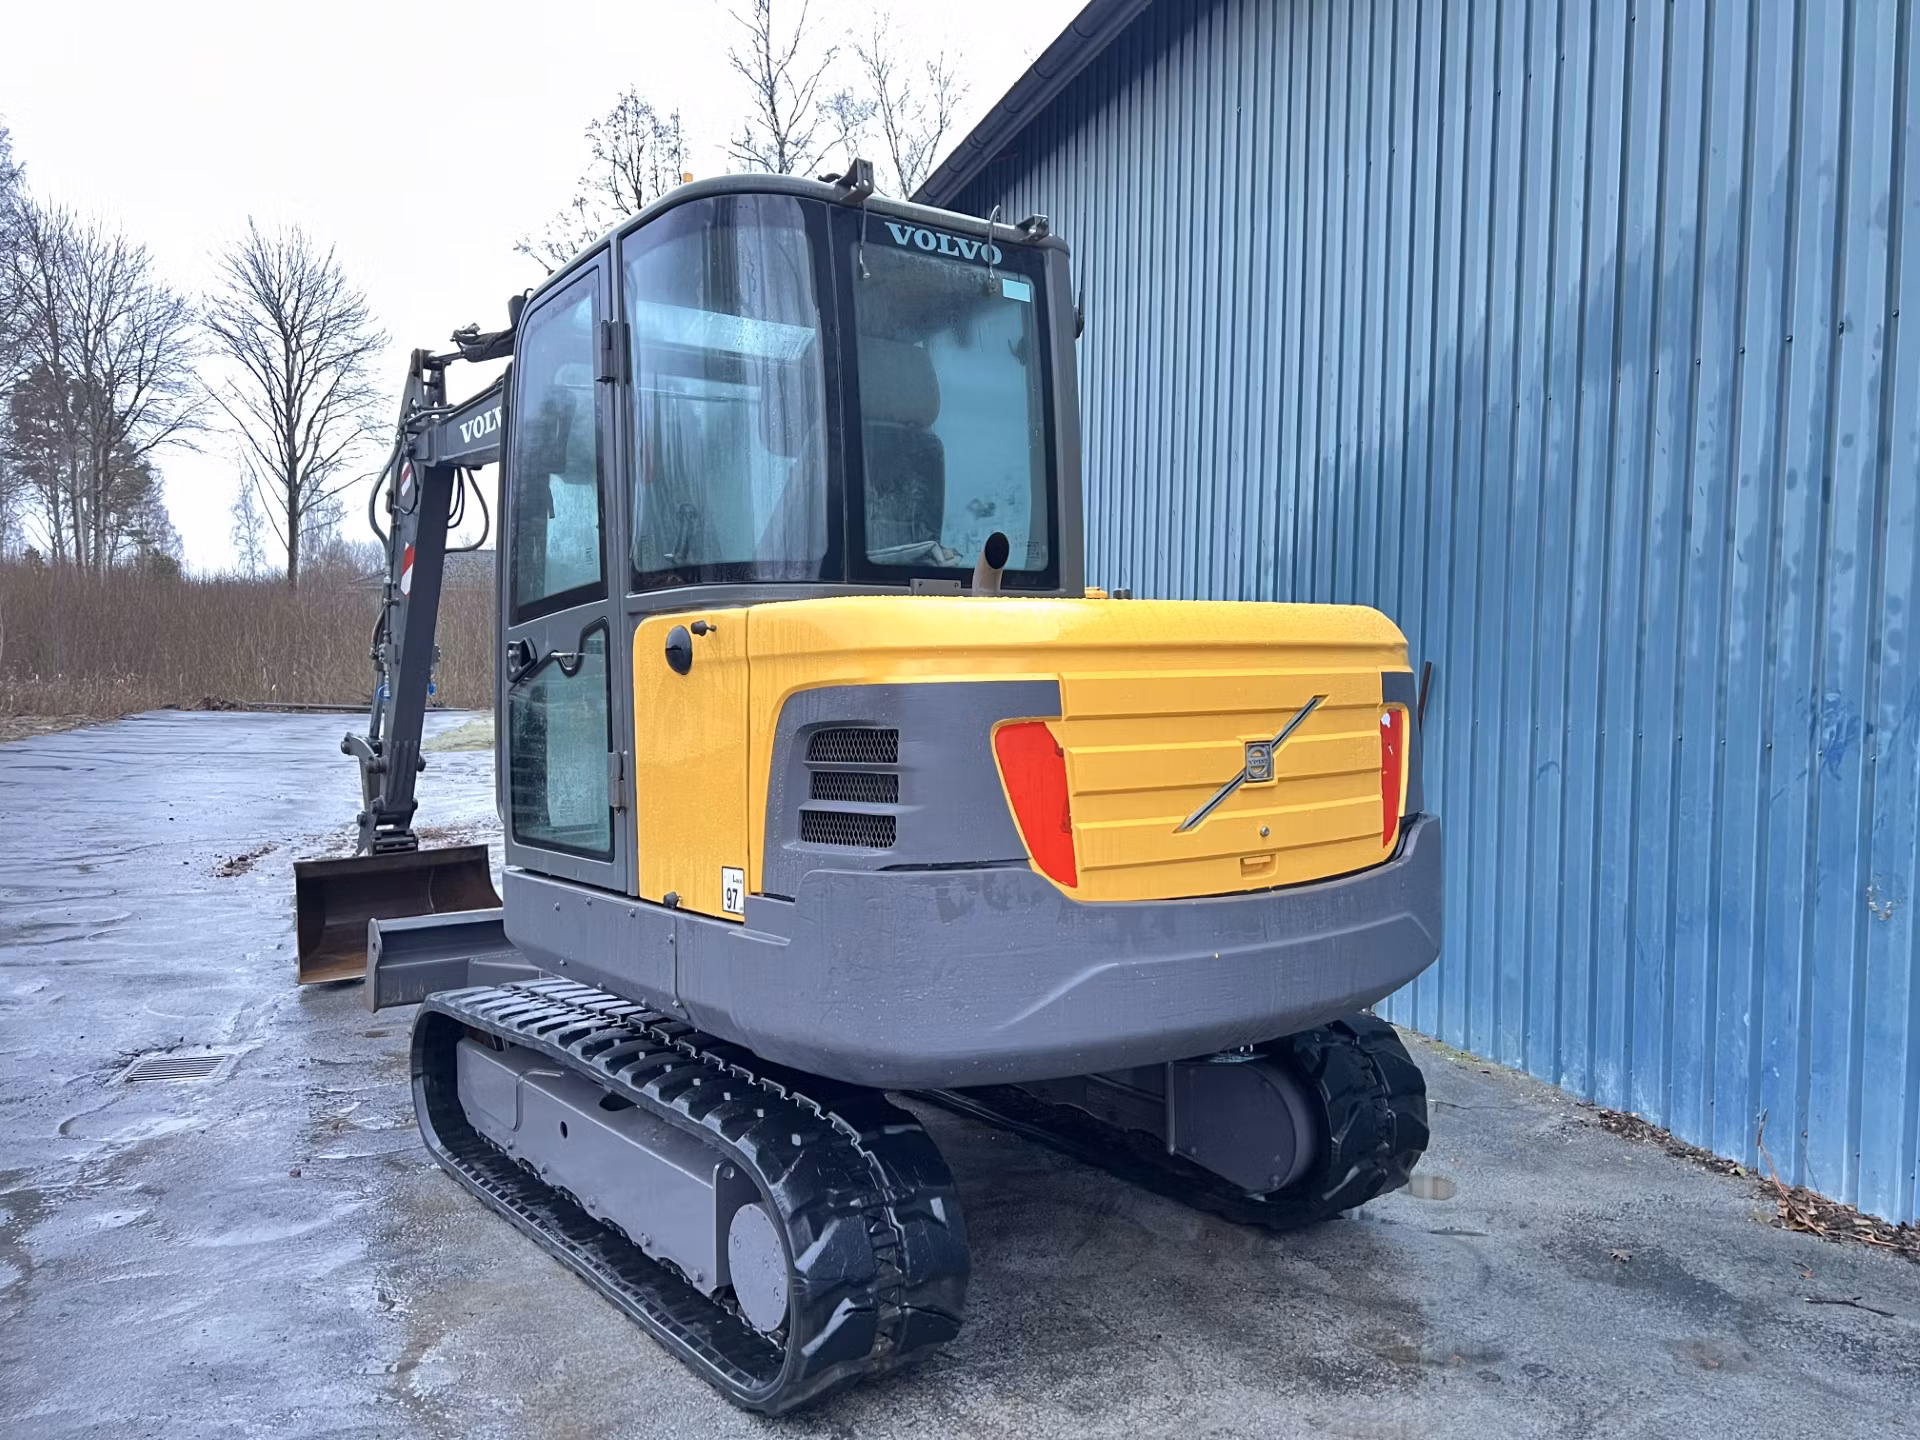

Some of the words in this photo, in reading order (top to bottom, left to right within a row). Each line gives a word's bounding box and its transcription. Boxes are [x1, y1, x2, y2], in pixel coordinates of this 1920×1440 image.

[885, 222, 1003, 265] VOLVO
[460, 406, 501, 443] VOLV
[726, 887, 738, 910] 97
